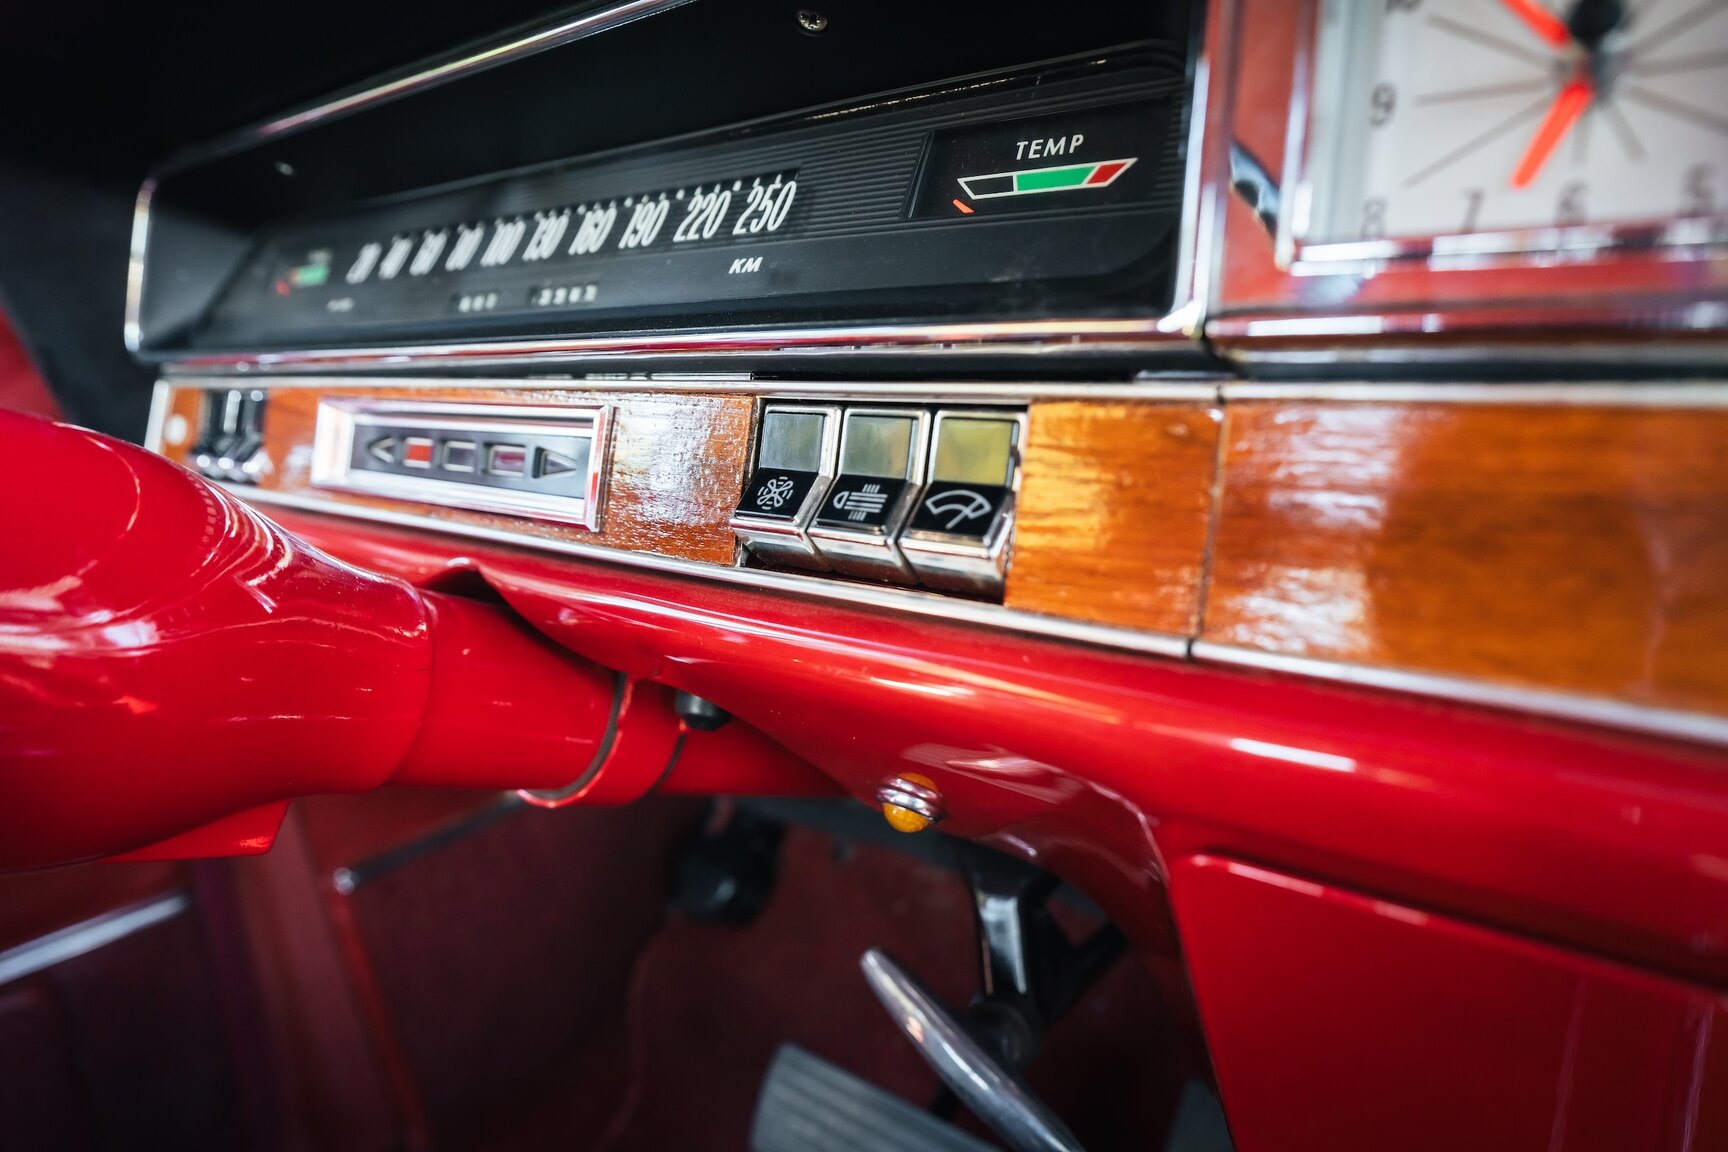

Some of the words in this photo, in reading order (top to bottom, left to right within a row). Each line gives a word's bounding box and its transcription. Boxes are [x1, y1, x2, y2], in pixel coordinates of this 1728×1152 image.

[1369, 81, 1396, 128] 9
[1015, 133, 1085, 161] TEMP
[617, 199, 671, 250] 190
[672, 189, 733, 243] 220
[732, 180, 798, 236] 250
[728, 256, 764, 275] KM
